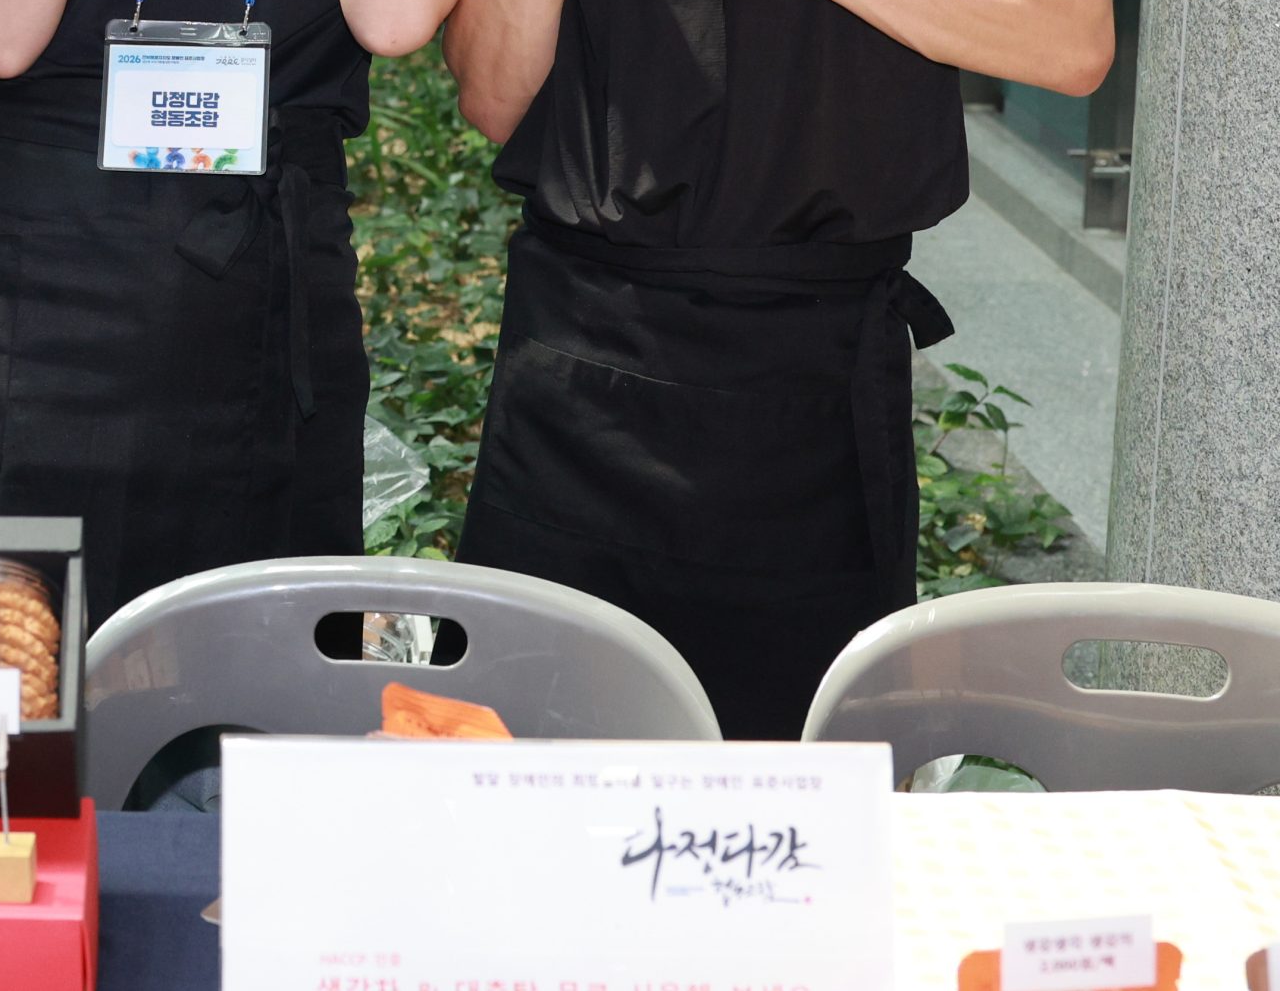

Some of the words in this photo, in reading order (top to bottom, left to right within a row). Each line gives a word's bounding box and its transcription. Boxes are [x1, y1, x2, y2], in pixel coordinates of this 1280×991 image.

[118, 54, 141, 64] 2026
[151, 91, 220, 109] 다정다감
[151, 110, 220, 128] 협동조합
[620, 806, 822, 903] 다정다감
